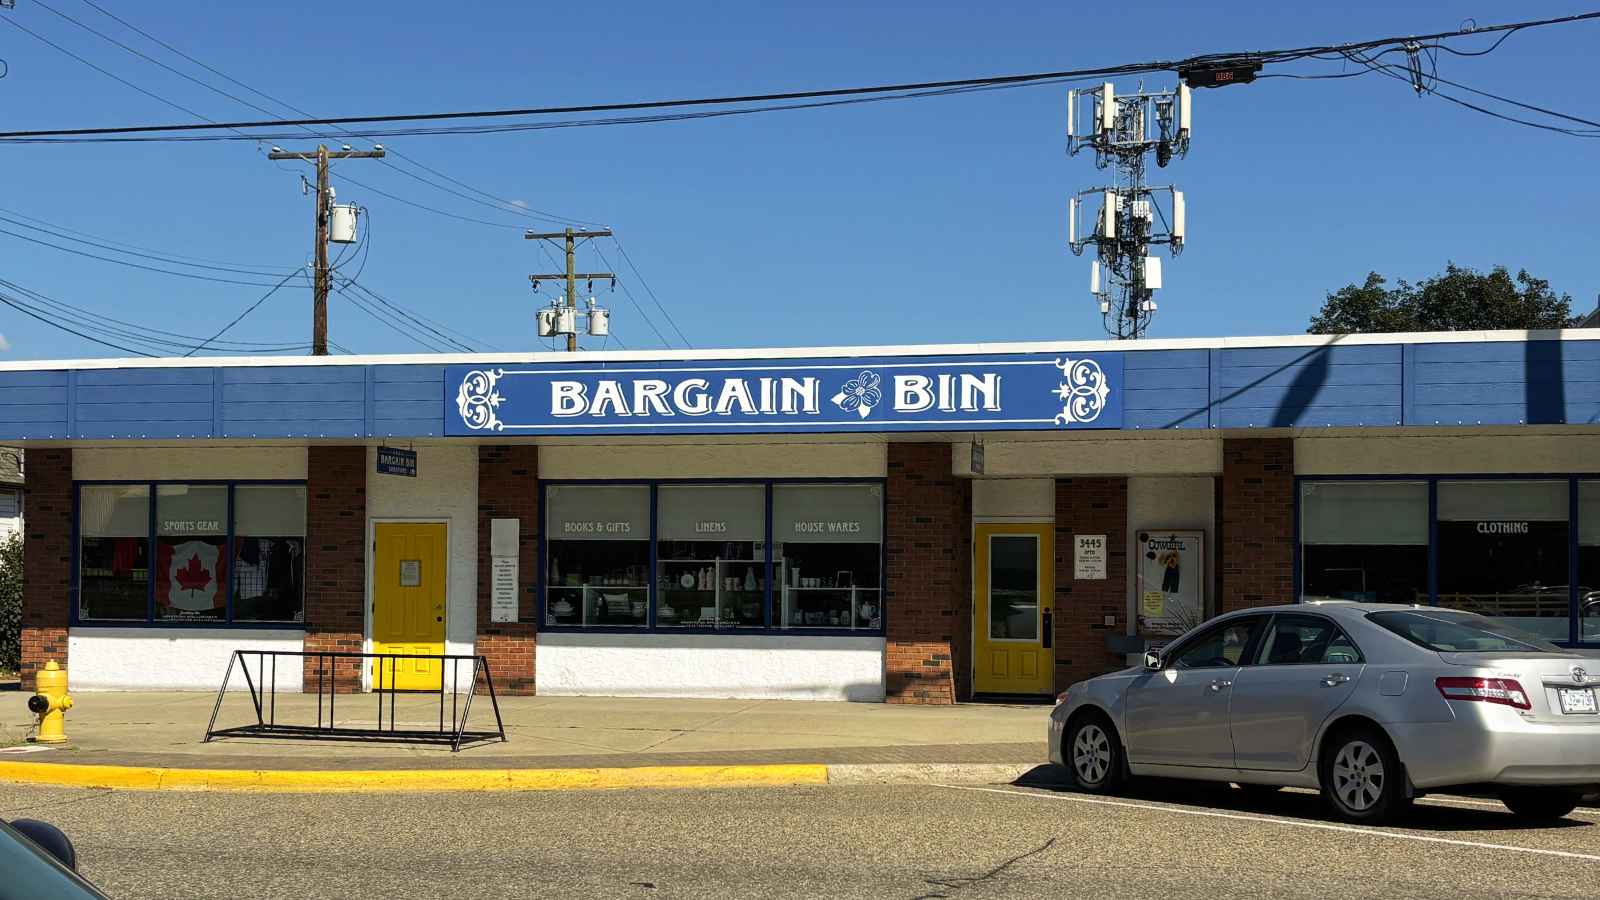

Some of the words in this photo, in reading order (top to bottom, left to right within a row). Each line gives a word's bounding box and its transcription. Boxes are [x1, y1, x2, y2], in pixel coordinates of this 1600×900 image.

[551, 377, 820, 417] BARGAIN
[893, 373, 1002, 413] BIN
[164, 520, 194, 533] SPORTS
[197, 521, 220, 532] GEAR
[564, 522, 594, 533] BOOKS
[596, 522, 605, 533] &
[606, 522, 632, 533] GIFTS
[695, 521, 727, 533] LINENS
[795, 521, 825, 533] HOUSE
[827, 521, 860, 533] WARES
[1476, 521, 1529, 534] CLOTHING
[1079, 538, 1102, 549] 3445
